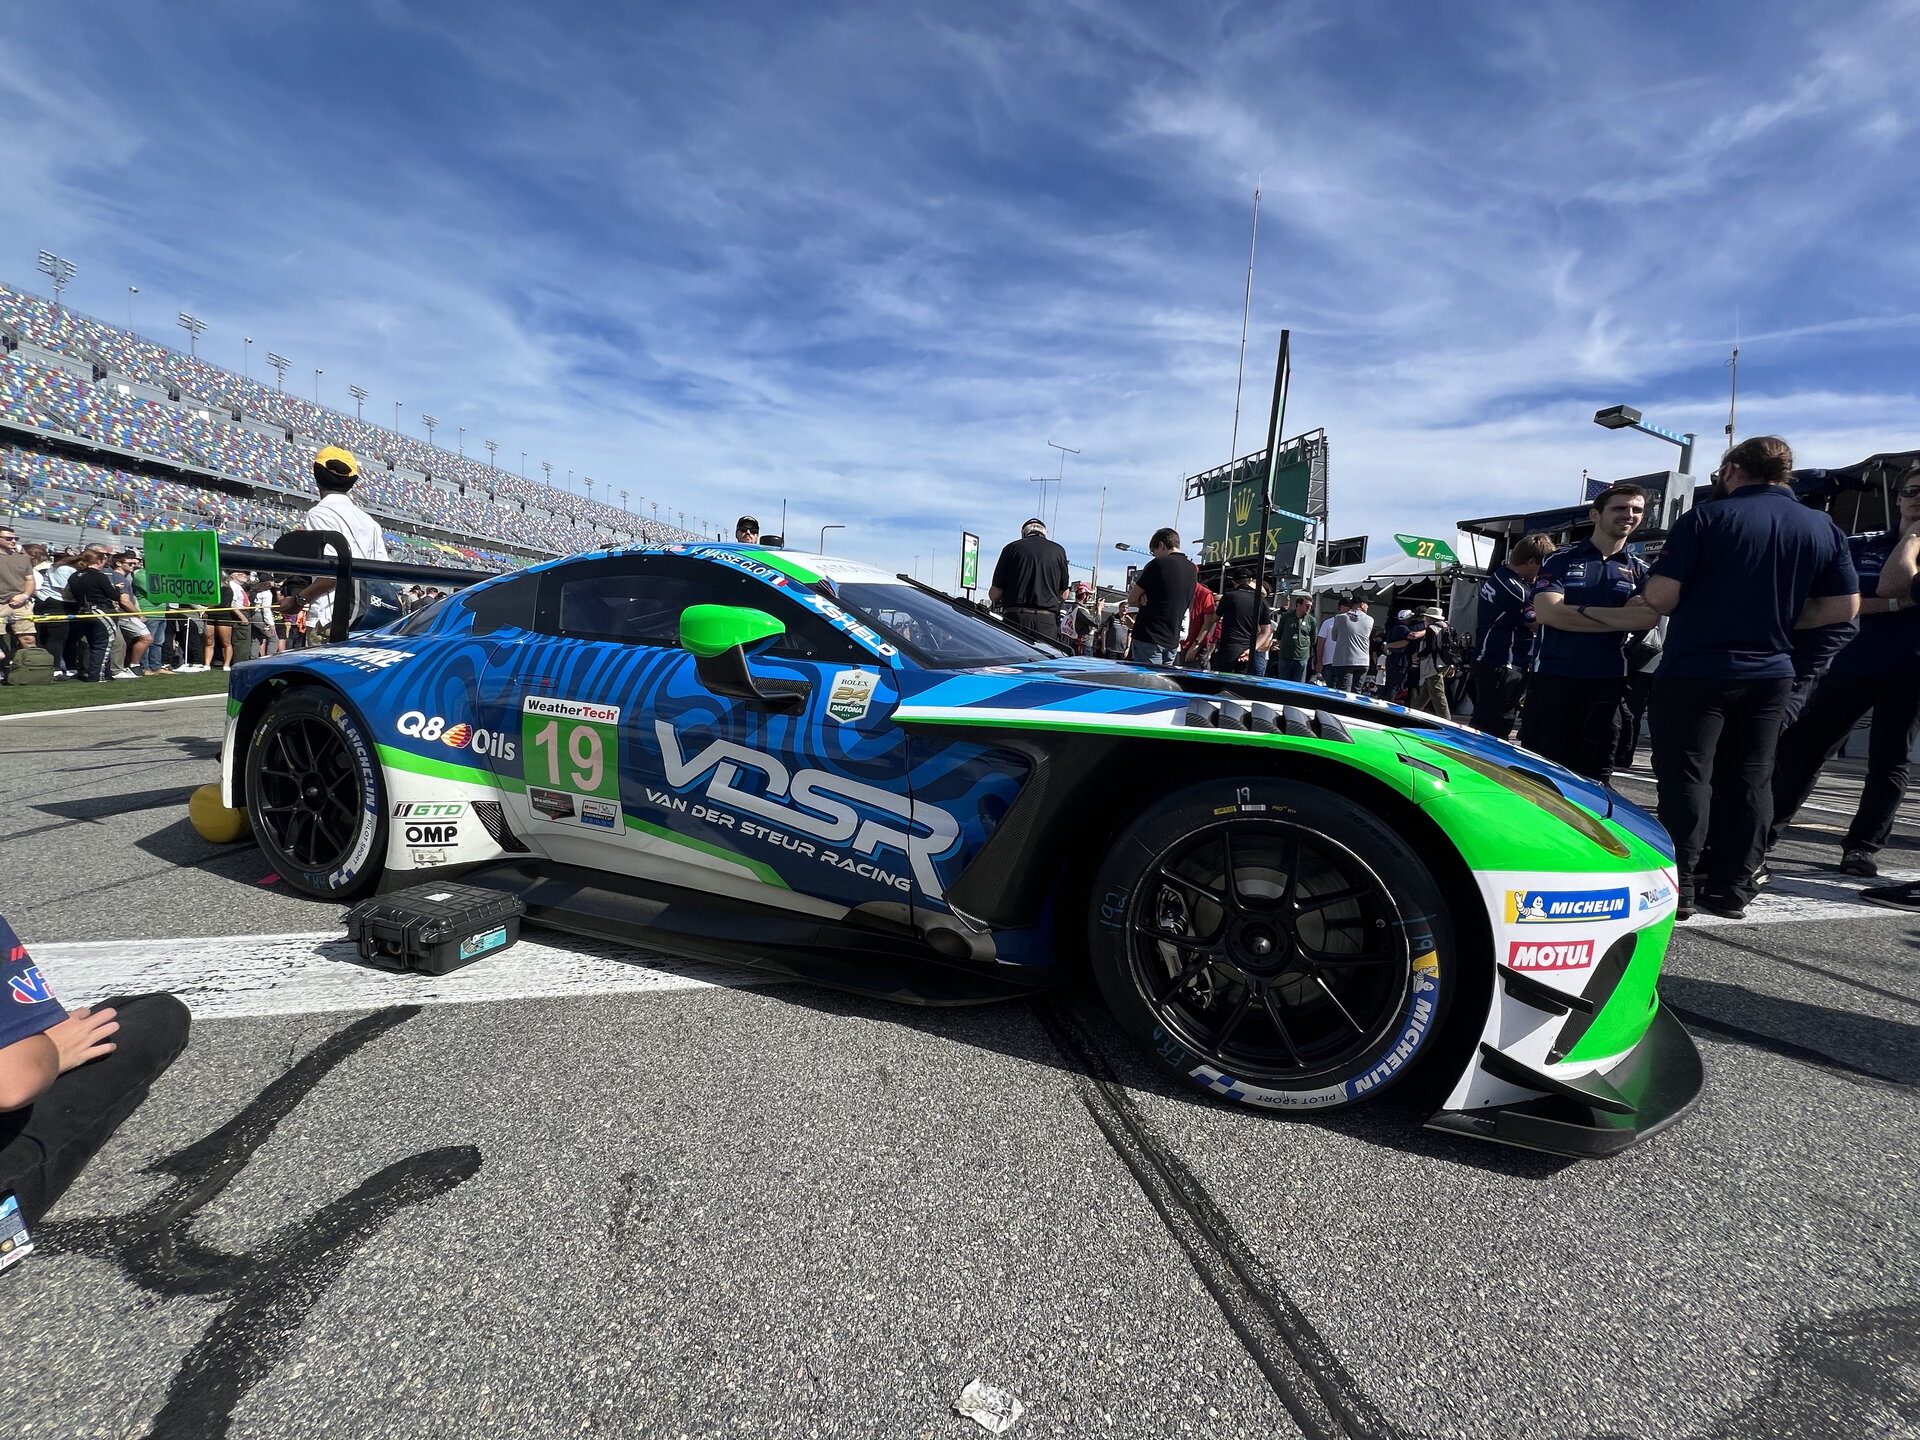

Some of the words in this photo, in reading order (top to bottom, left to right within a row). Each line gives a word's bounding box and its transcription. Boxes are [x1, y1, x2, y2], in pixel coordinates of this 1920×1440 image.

[691, 546, 702, 554] V.
[1209, 528, 1282, 562] ROLEX
[1416, 541, 1434, 557] 27
[964, 556, 975, 577] 21
[160, 574, 215, 598] Fragrance
[803, 594, 896, 656] XSHIELD
[841, 679, 868, 687] ROLEX
[832, 687, 870, 701] 24
[528, 699, 615, 720] WeatherTech
[831, 704, 863, 713] DAYTONA
[397, 711, 445, 741] Q8
[472, 728, 516, 760] Oils
[536, 720, 603, 791] 19
[346, 728, 377, 808] MICHELIN
[1236, 786, 1250, 804] 19
[413, 804, 462, 816] GTD
[655, 719, 960, 900] VDSR
[363, 819, 373, 842] PILOT
[405, 826, 458, 843] OMP
[645, 788, 688, 814] VAN
[691, 804, 735, 829] DER
[738, 821, 817, 857] STEUR
[820, 850, 912, 892] RACING
[353, 842, 366, 865] SPORT
[1550, 898, 1625, 915] MICHELIN
[1512, 944, 1591, 967] MOTUL
[1354, 997, 1433, 1094] MICHELIN
[1255, 1094, 1298, 1105] SPORT
[1301, 1094, 1336, 1105] PILOT
